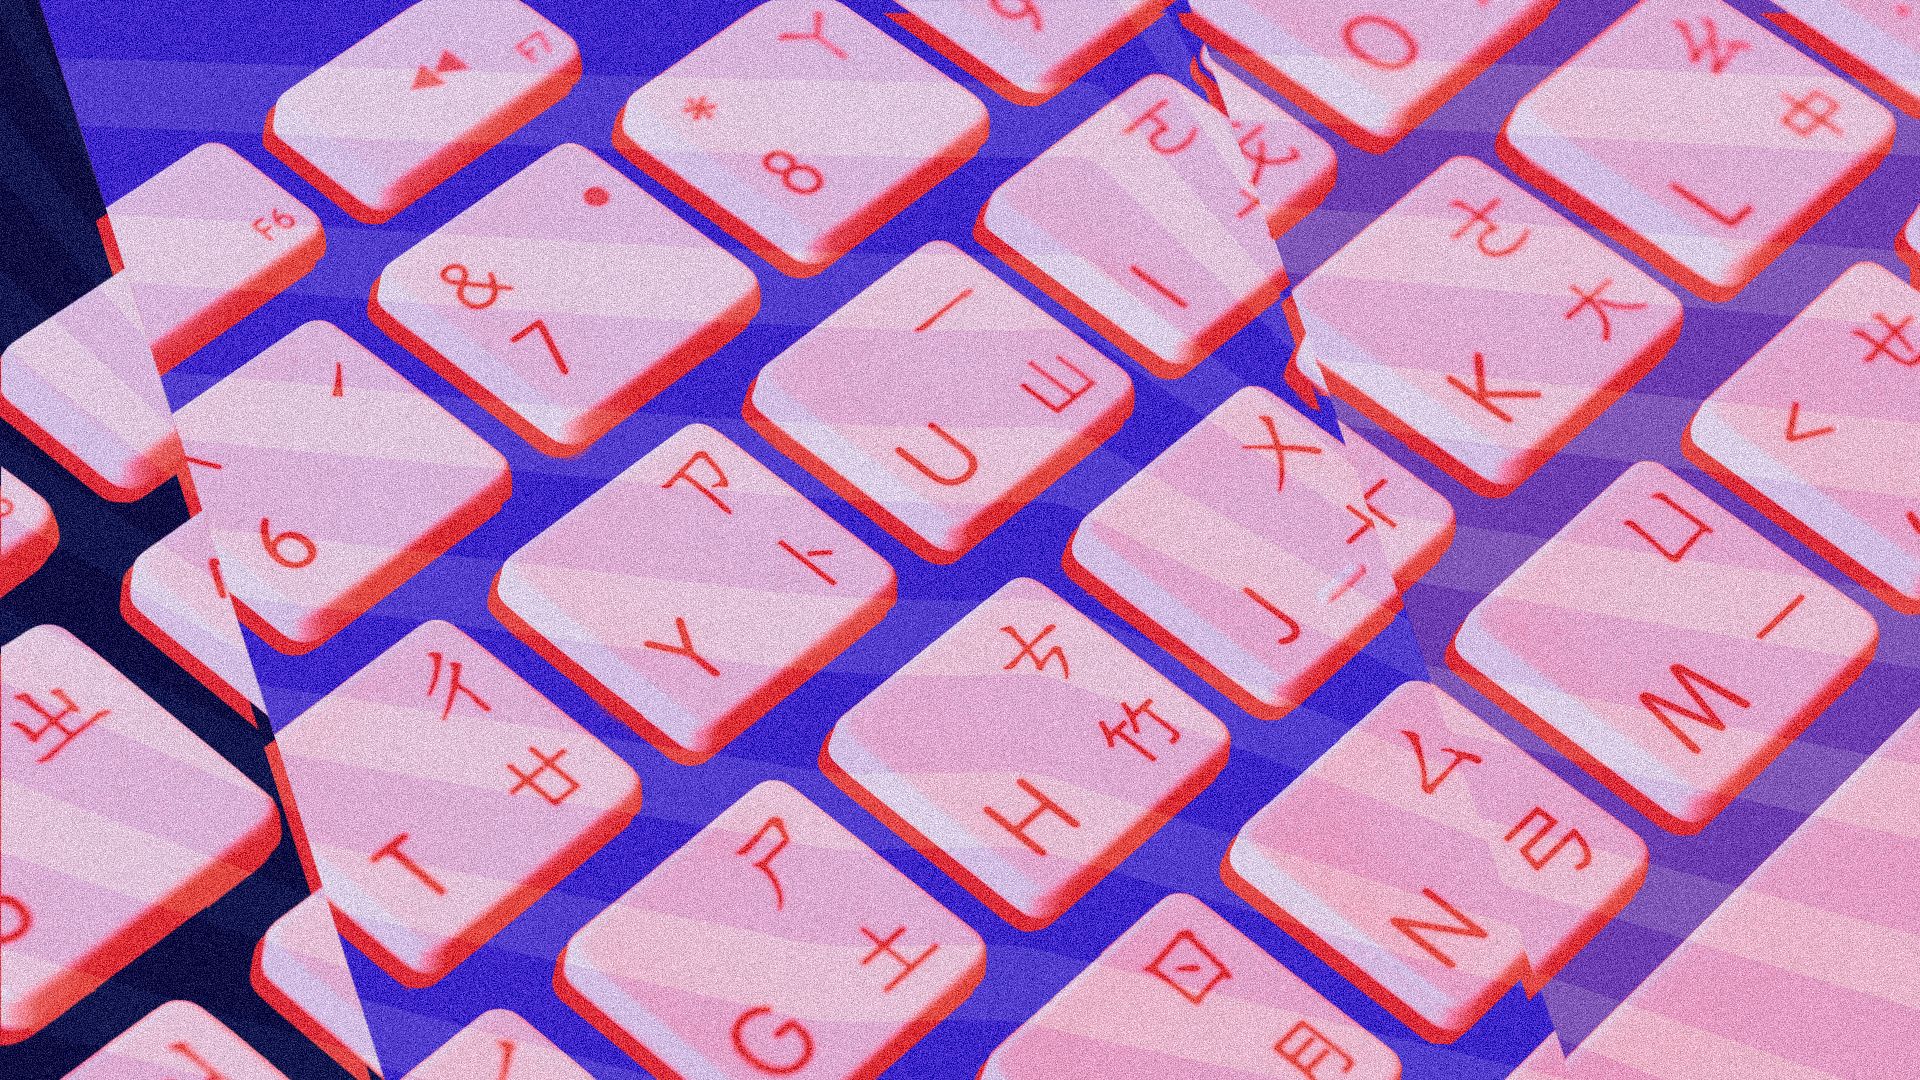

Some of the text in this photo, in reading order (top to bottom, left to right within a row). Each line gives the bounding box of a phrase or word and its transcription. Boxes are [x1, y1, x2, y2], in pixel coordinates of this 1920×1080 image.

[1340, 13, 1420, 70] O
[761, 150, 826, 196] 8
[251, 207, 298, 241] F6
[1669, 181, 1755, 229] L
[439, 262, 513, 312] &
[510, 318, 570, 376] 7
[1019, 355, 1097, 415] 山
[1445, 350, 1542, 424] K
[894, 420, 979, 487] U
[258, 516, 318, 570] 6
[643, 616, 722, 679] Y
[1243, 587, 1303, 647] J
[1097, 698, 1182, 763] 竹
[1637, 662, 1752, 754] M
[982, 777, 1081, 859] H
[1504, 806, 1592, 871] 弓
[370, 831, 446, 896] T
[1389, 885, 1489, 970] N
[729, 1006, 816, 1077] G
